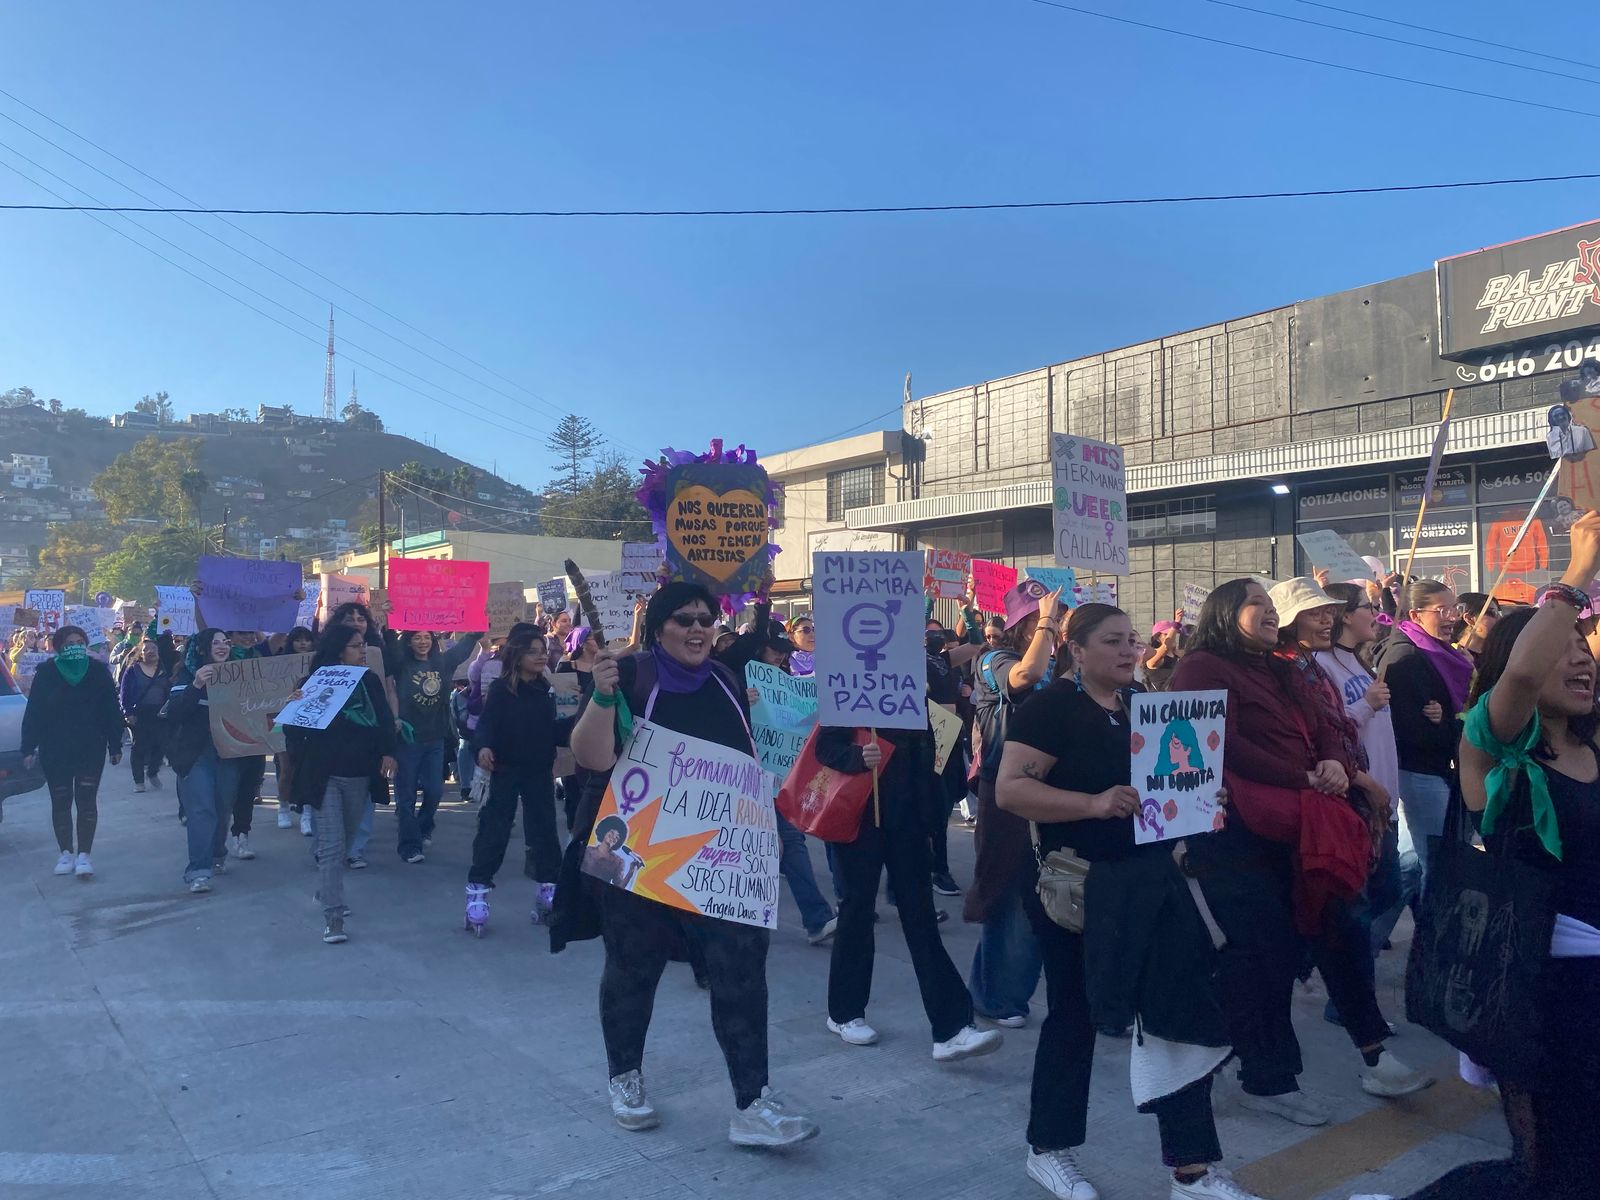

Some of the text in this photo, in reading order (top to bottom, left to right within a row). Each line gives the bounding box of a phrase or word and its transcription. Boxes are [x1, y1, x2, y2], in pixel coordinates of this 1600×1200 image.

[1476, 258, 1580, 310] BAJA
[1480, 283, 1597, 334] POINT
[1479, 348, 1536, 382] 646
[1082, 444, 1120, 472] MIS
[1055, 461, 1124, 491] HERMANAS
[1439, 479, 1465, 487] TARJETA
[1494, 474, 1521, 488] 646
[678, 500, 764, 518] NOS QUIEREN
[1055, 487, 1123, 521] QUEER
[1299, 487, 1387, 508] COTIZACIONES
[675, 518, 766, 533] MUSAS PORQUE
[1400, 521, 1468, 533] DISRIBUIDOR
[682, 534, 761, 547] NOS TEMEN
[1060, 529, 1125, 565] CALLADAS
[687, 548, 745, 563] ARTISTAS
[825, 555, 909, 575] MISMA
[822, 576, 918, 596] CHAMBA
[317, 679, 357, 689] están?
[748, 663, 773, 684] NOS
[828, 672, 916, 691] MISMA
[762, 686, 788, 705] TENER
[834, 690, 920, 716] PAGA
[1140, 698, 1227, 725] NI CALLADITA
[1168, 767, 1215, 792] BONITA
[663, 788, 688, 817] LA
[697, 790, 731, 823] IDEA
[718, 826, 738, 850] DE
[741, 828, 766, 858] QUE
[697, 845, 768, 875] mujeres SON
[681, 864, 725, 894] SERES
